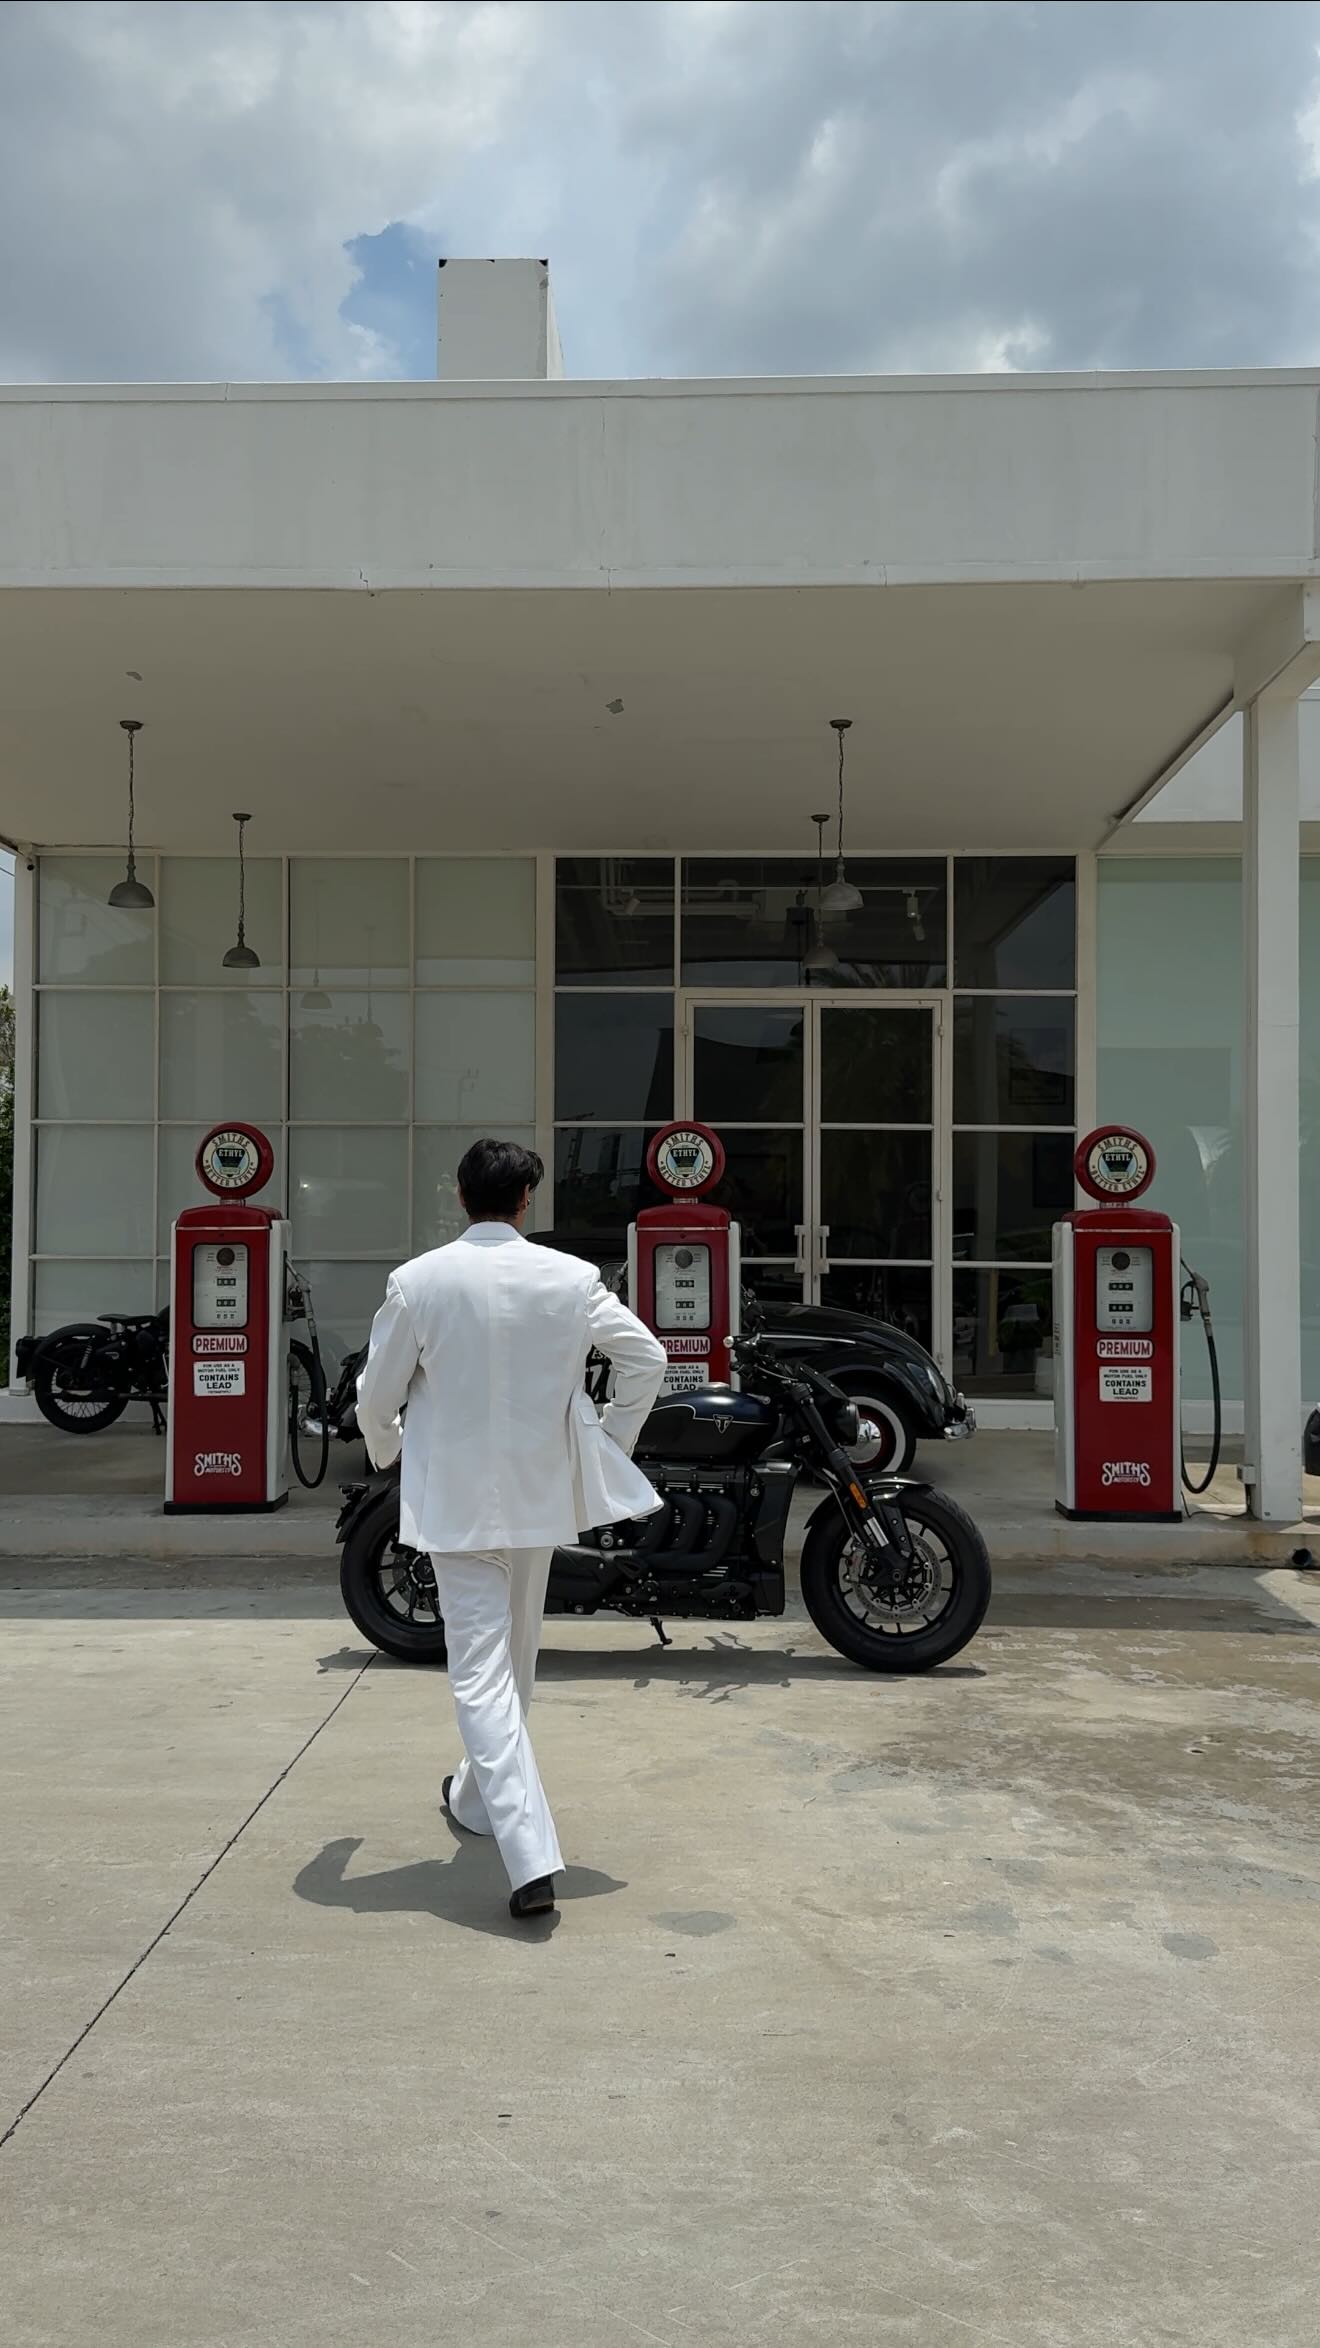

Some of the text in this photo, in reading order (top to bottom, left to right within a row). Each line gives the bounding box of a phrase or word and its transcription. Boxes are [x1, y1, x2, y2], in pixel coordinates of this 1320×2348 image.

[212, 1134, 250, 1148] SMITHS
[665, 1133, 704, 1148] SMITHS
[1097, 1137, 1138, 1151] SMITHS
[219, 1149, 243, 1157] ETHYL
[672, 1149, 698, 1157] ETHYL
[204, 1165, 256, 1186] BETTER ETHYL
[660, 1165, 711, 1187] BETTER ETHYL
[1090, 1170, 1145, 1191] BETTER ETHYL
[196, 1338, 245, 1351] PREMIUM
[1099, 1341, 1150, 1355] PREMIUM
[194, 1453, 242, 1477] SMITHS
[1102, 1462, 1151, 1486] SMITHS
